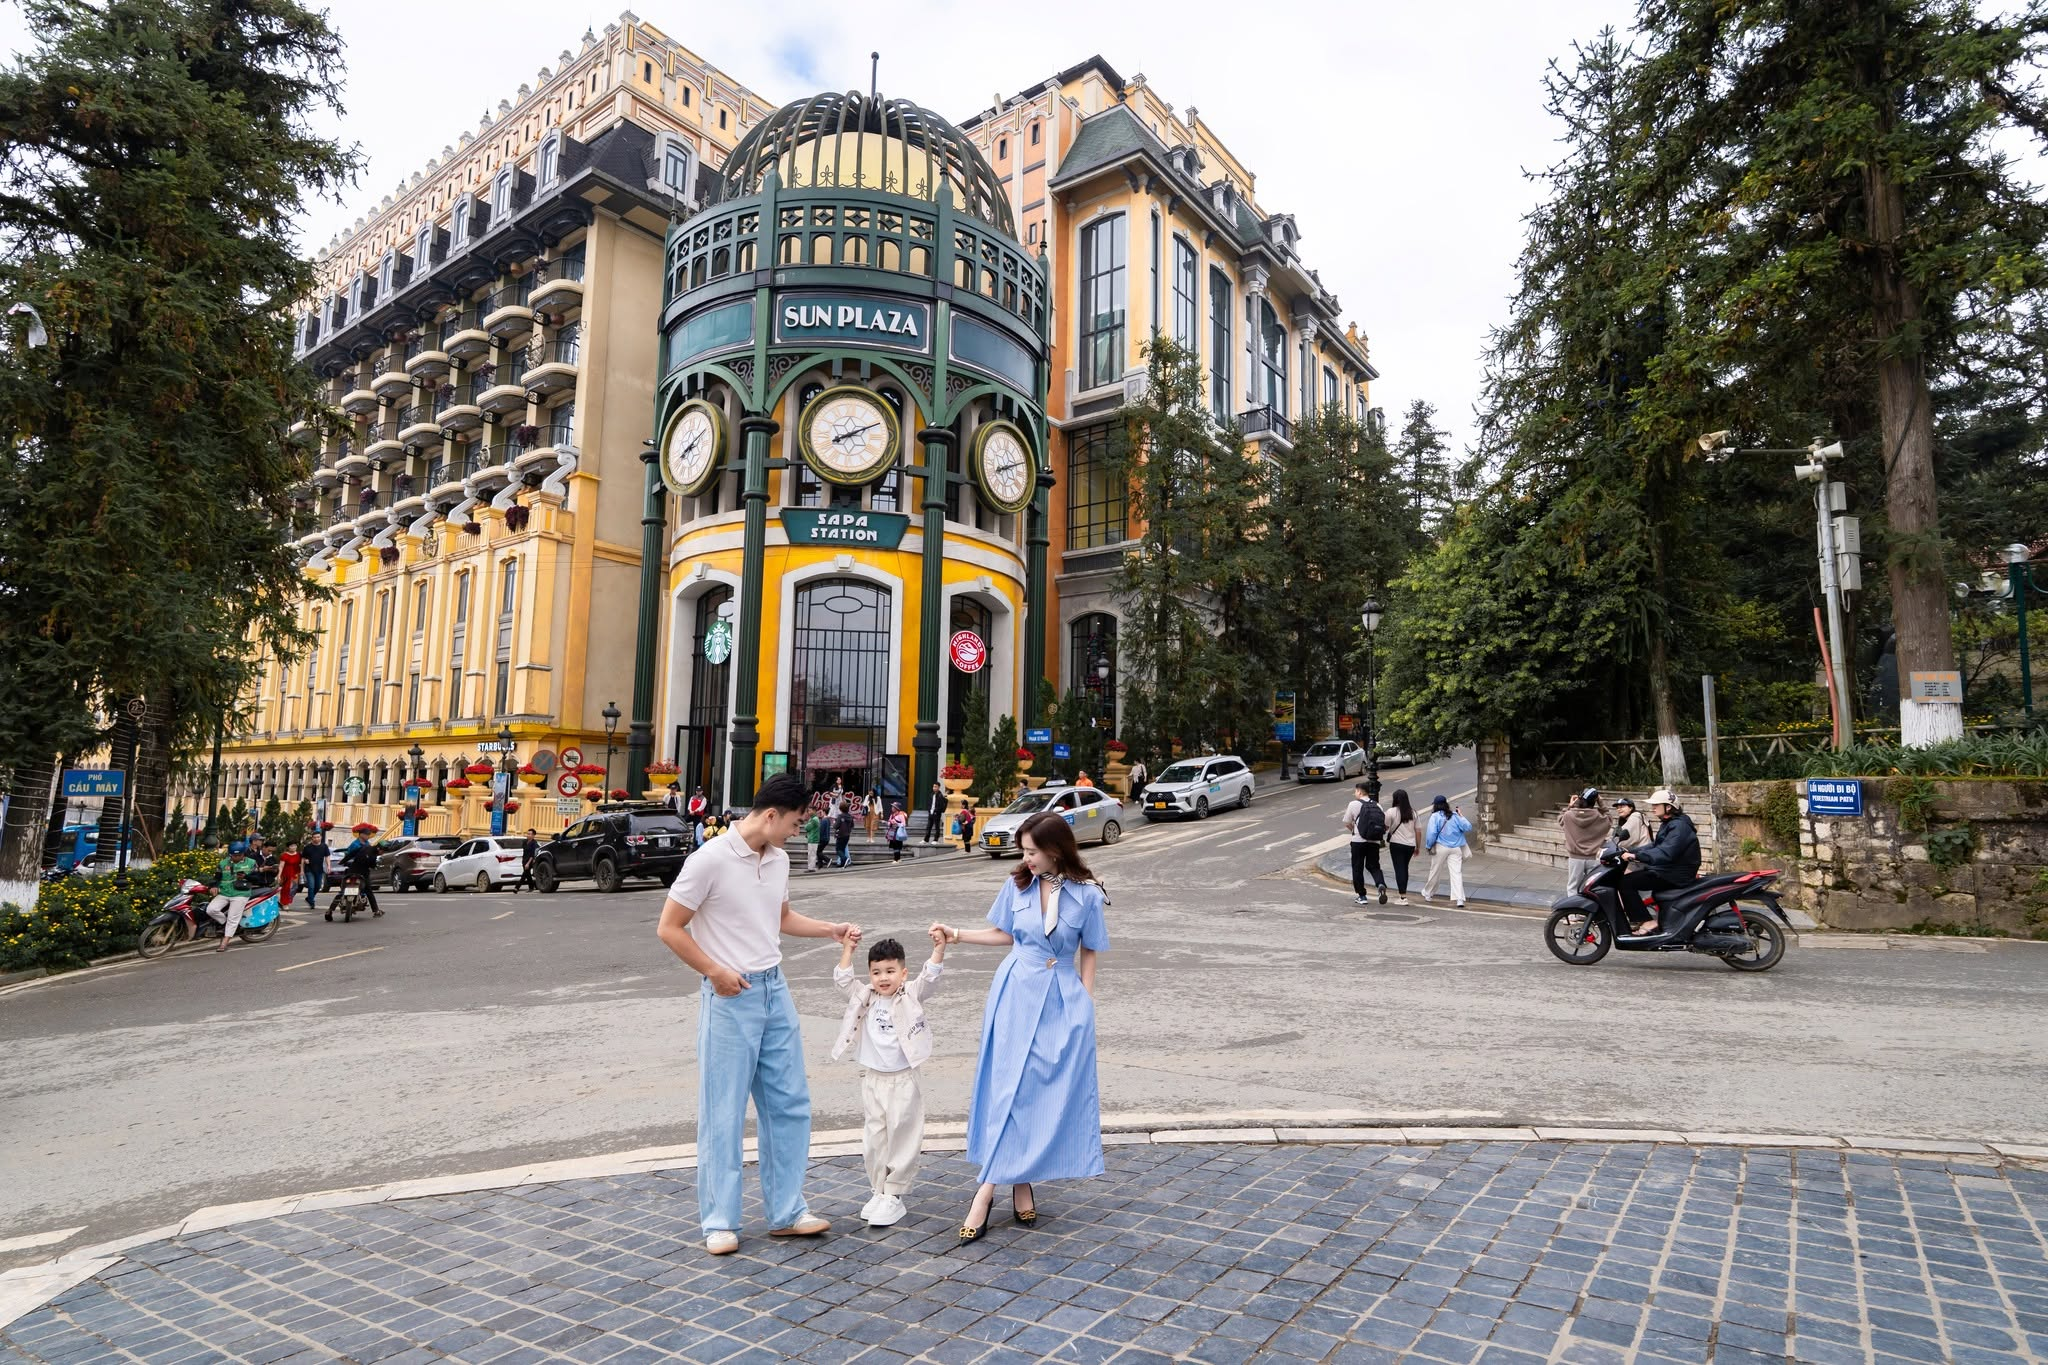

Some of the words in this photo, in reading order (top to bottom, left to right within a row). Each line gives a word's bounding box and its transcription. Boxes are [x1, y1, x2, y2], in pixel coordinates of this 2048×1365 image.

[784, 305, 832, 328] SUN
[837, 305, 919, 336] PLAZA
[818, 513, 868, 527] SAPA
[811, 527, 878, 542] STATION
[952, 633, 984, 652] HIGHLANDS
[955, 658, 980, 670] COFFEE
[477, 741, 515, 751] STARBUS
[88, 772, 103, 781] PHỐ
[95, 782, 118, 792] MÂY
[1845, 783, 1857, 795] BỘ
